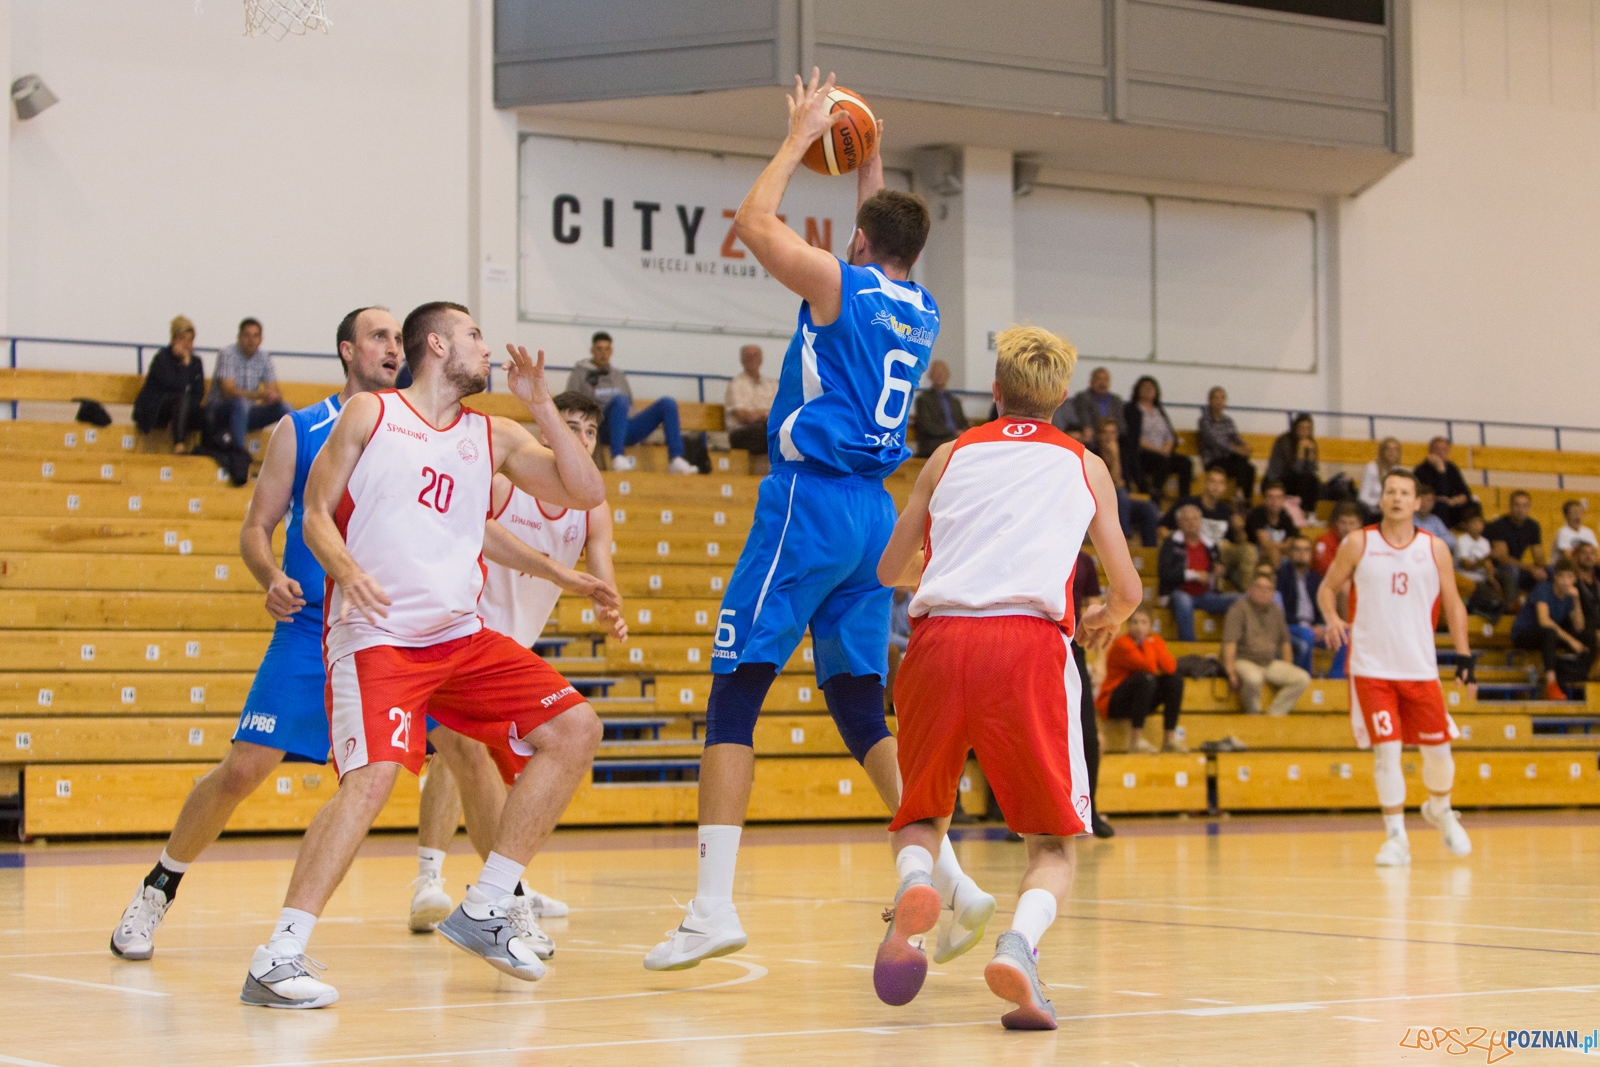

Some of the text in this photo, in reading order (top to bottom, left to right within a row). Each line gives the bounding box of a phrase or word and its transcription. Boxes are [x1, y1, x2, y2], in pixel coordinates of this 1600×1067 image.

[840, 126, 857, 169] molten
[552, 193, 833, 260] CITYZN
[875, 349, 918, 429] 6
[387, 423, 428, 443] SPALDING
[418, 466, 455, 514] 20
[510, 514, 542, 531] SPALDING
[1392, 572, 1409, 596] 13
[715, 609, 736, 648] 6
[249, 715, 277, 734] PBG
[1372, 709, 1394, 738] 13
